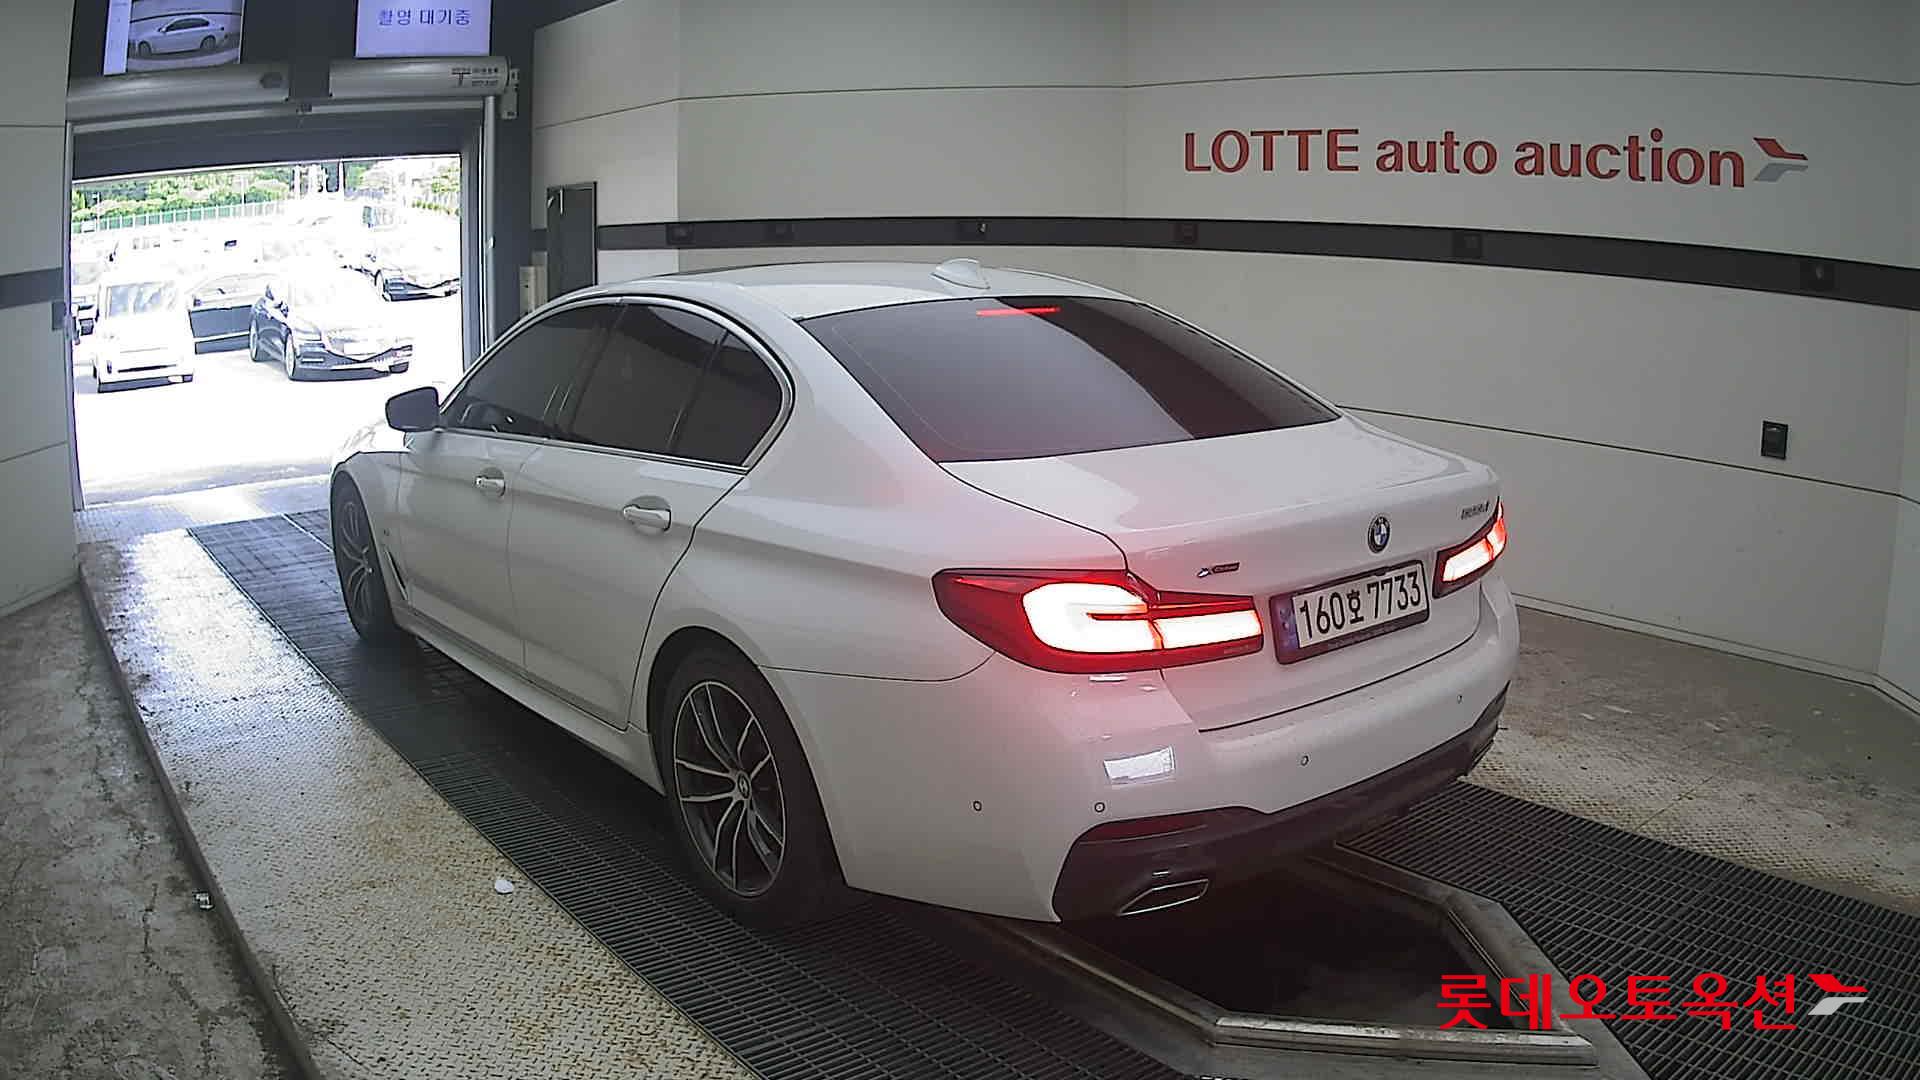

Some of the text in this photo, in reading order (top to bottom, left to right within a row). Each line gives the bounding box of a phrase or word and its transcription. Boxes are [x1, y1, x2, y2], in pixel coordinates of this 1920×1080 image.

[420, 8, 471, 26] 대기중
[1184, 128, 1745, 188] LOTTE auto auction
